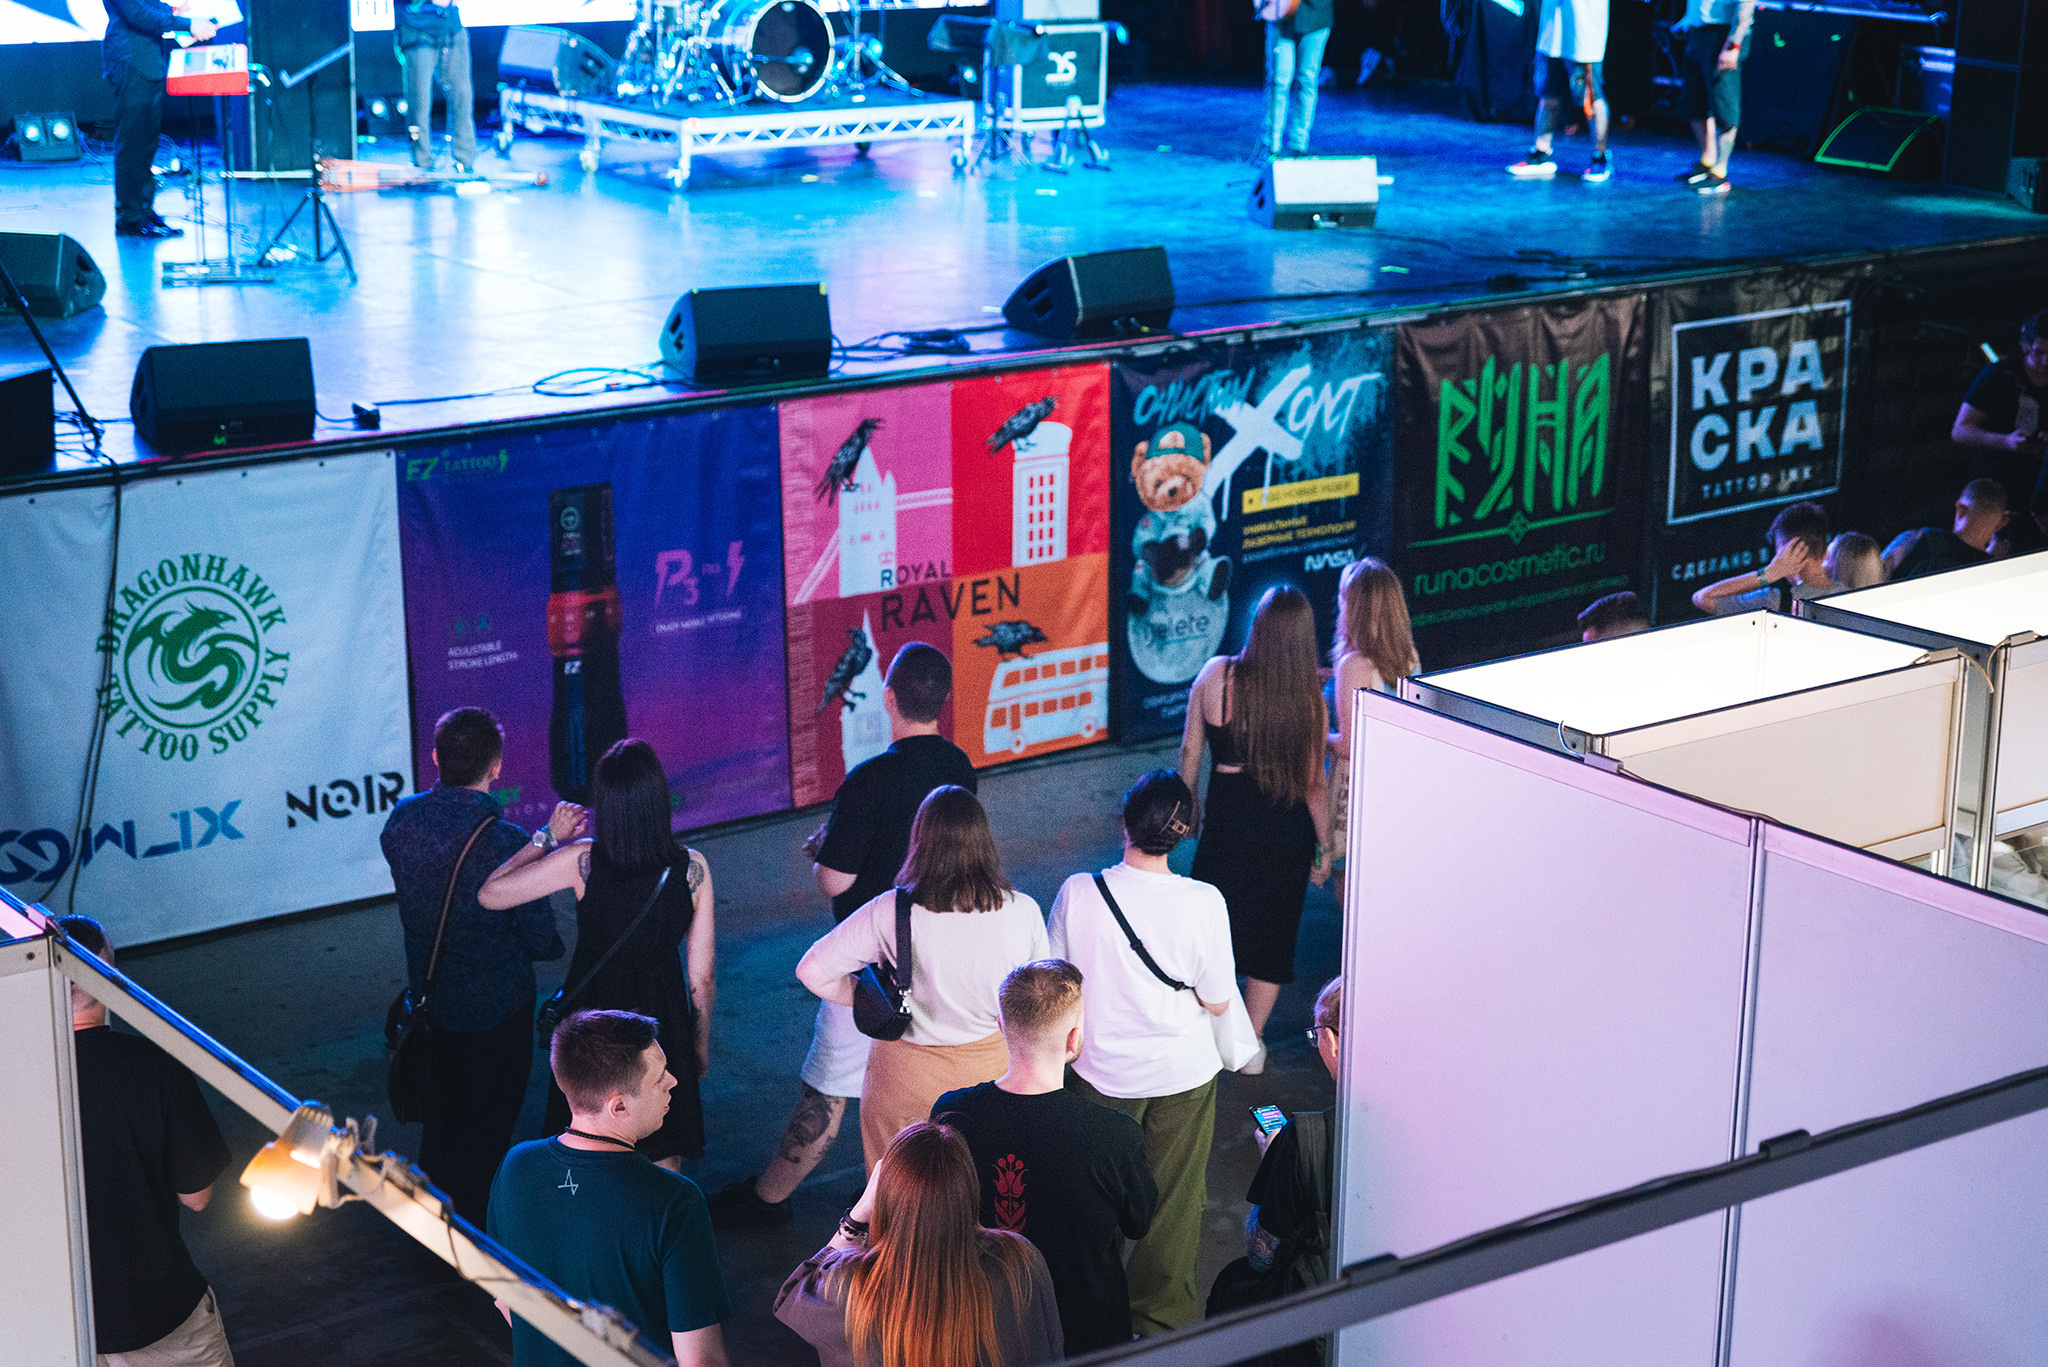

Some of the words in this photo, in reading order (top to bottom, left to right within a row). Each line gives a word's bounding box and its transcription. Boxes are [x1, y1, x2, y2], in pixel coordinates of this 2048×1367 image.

[1691, 339, 1827, 411] КРА
[1690, 400, 1824, 472] СКА
[1702, 472, 1771, 499] TATTOO
[1779, 465, 1812, 486] INK
[881, 560, 951, 588] ROYAL
[1414, 542, 1606, 596] runacosmetic.ru
[1671, 550, 1752, 581] СДЕЛАНО
[881, 572, 1020, 633] RAVEN
[208, 646, 291, 755] SUPPLY
[286, 771, 405, 829] NOIR
